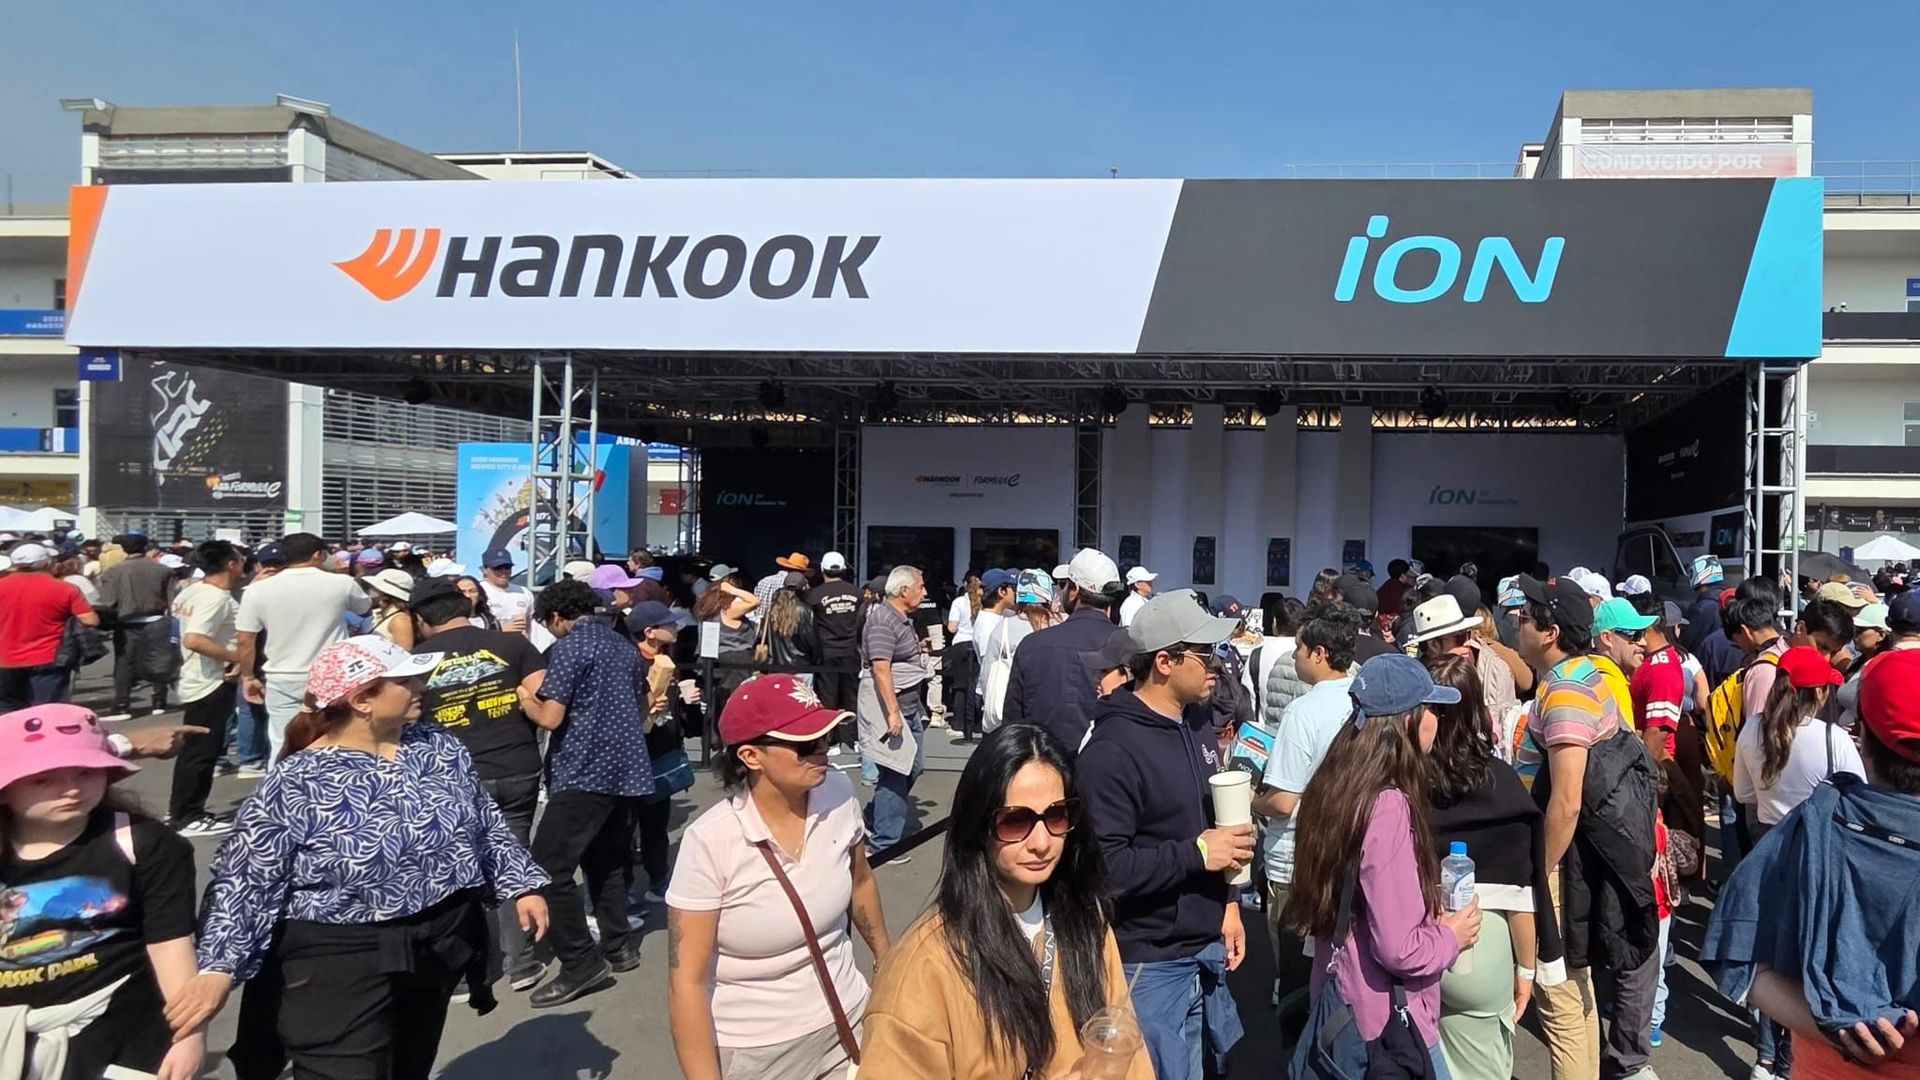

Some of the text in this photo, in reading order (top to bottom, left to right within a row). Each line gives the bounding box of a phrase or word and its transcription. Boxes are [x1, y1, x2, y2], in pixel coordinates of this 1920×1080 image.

[1583, 153, 1762, 170] CONDUCIDO POR
[1334, 215, 1565, 303] iON
